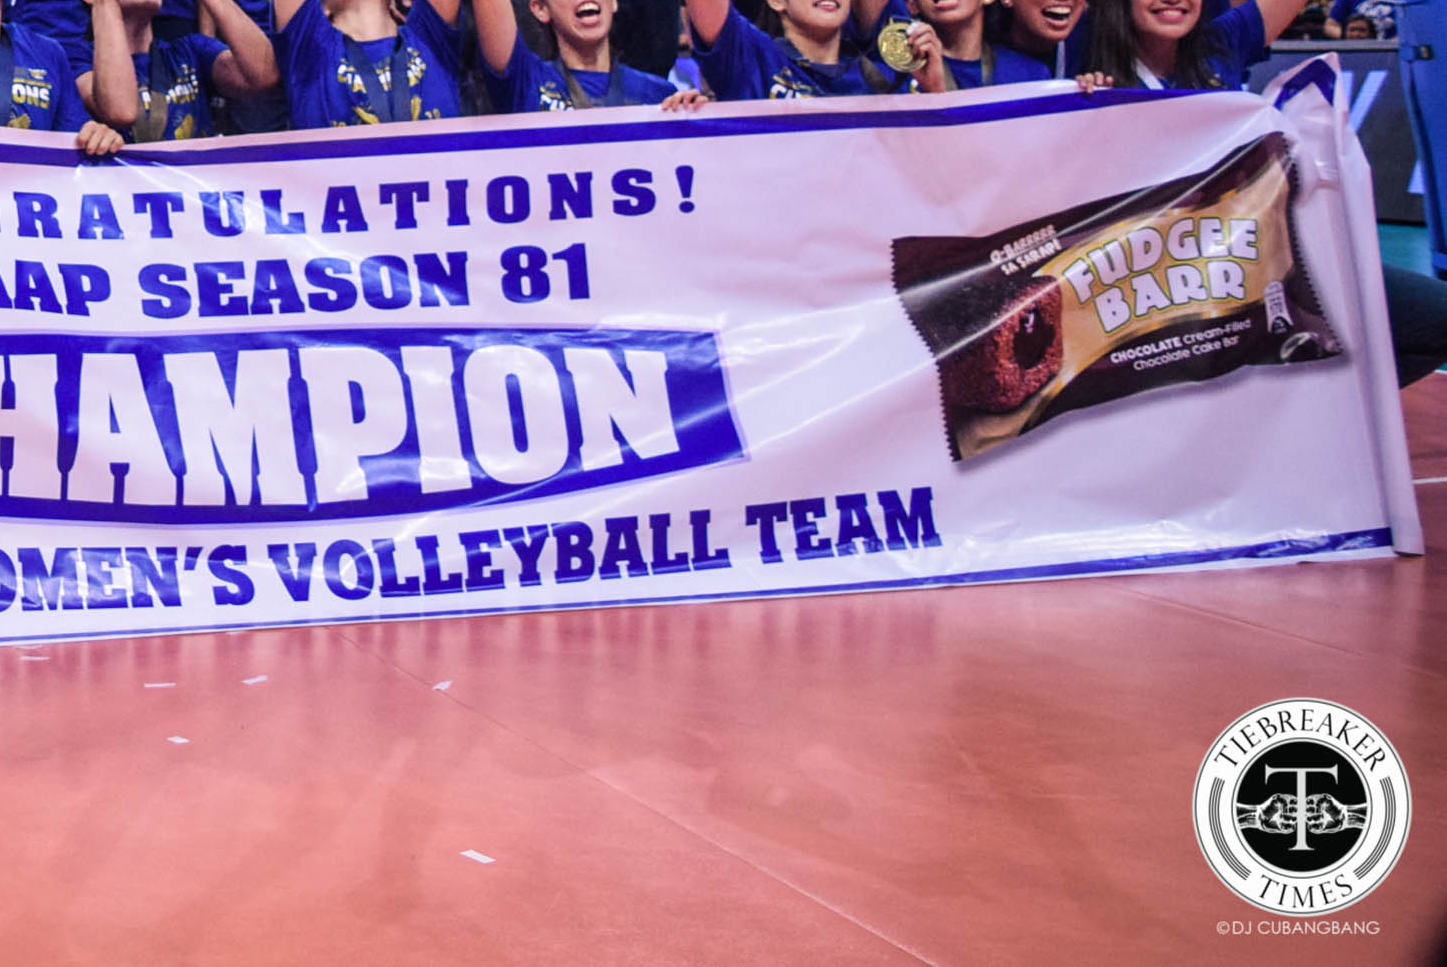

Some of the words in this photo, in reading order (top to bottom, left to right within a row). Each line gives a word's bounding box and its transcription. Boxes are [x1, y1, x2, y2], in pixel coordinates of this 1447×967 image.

[137, 250, 469, 319] SEASON
[500, 242, 591, 304] 81
[1062, 216, 1259, 305] FUDGEE
[1093, 259, 1246, 334] BARR
[1110, 336, 1184, 364] CHOCOLATE
[1133, 348, 1191, 371] Chocolate
[1191, 339, 1222, 356] Cake
[267, 509, 732, 602] VOLLEYBALL
[745, 486, 942, 566] TEAM
